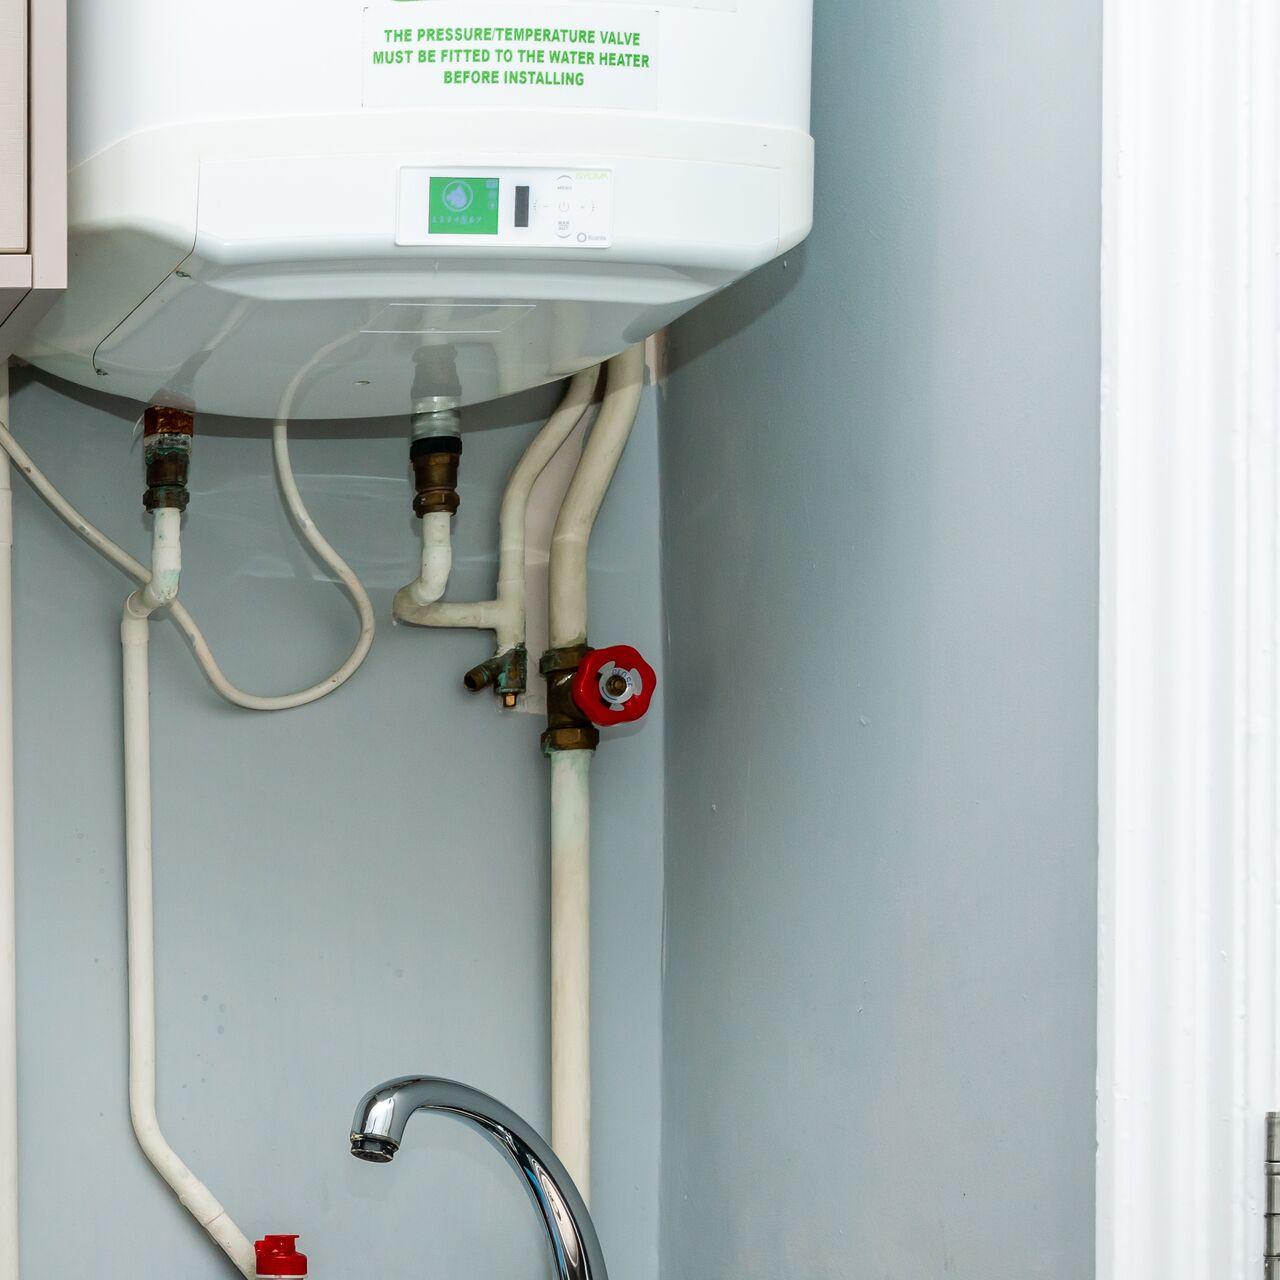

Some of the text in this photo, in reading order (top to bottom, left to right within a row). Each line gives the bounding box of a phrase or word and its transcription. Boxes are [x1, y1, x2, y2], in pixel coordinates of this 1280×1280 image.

[384, 27, 640, 46] THE PRESSURE/TEMPERATURE VALVE
[373, 49, 650, 68] MUST BE FITTED TO THE WATER HEATER
[443, 70, 584, 86] BEFORE INSTALLING
